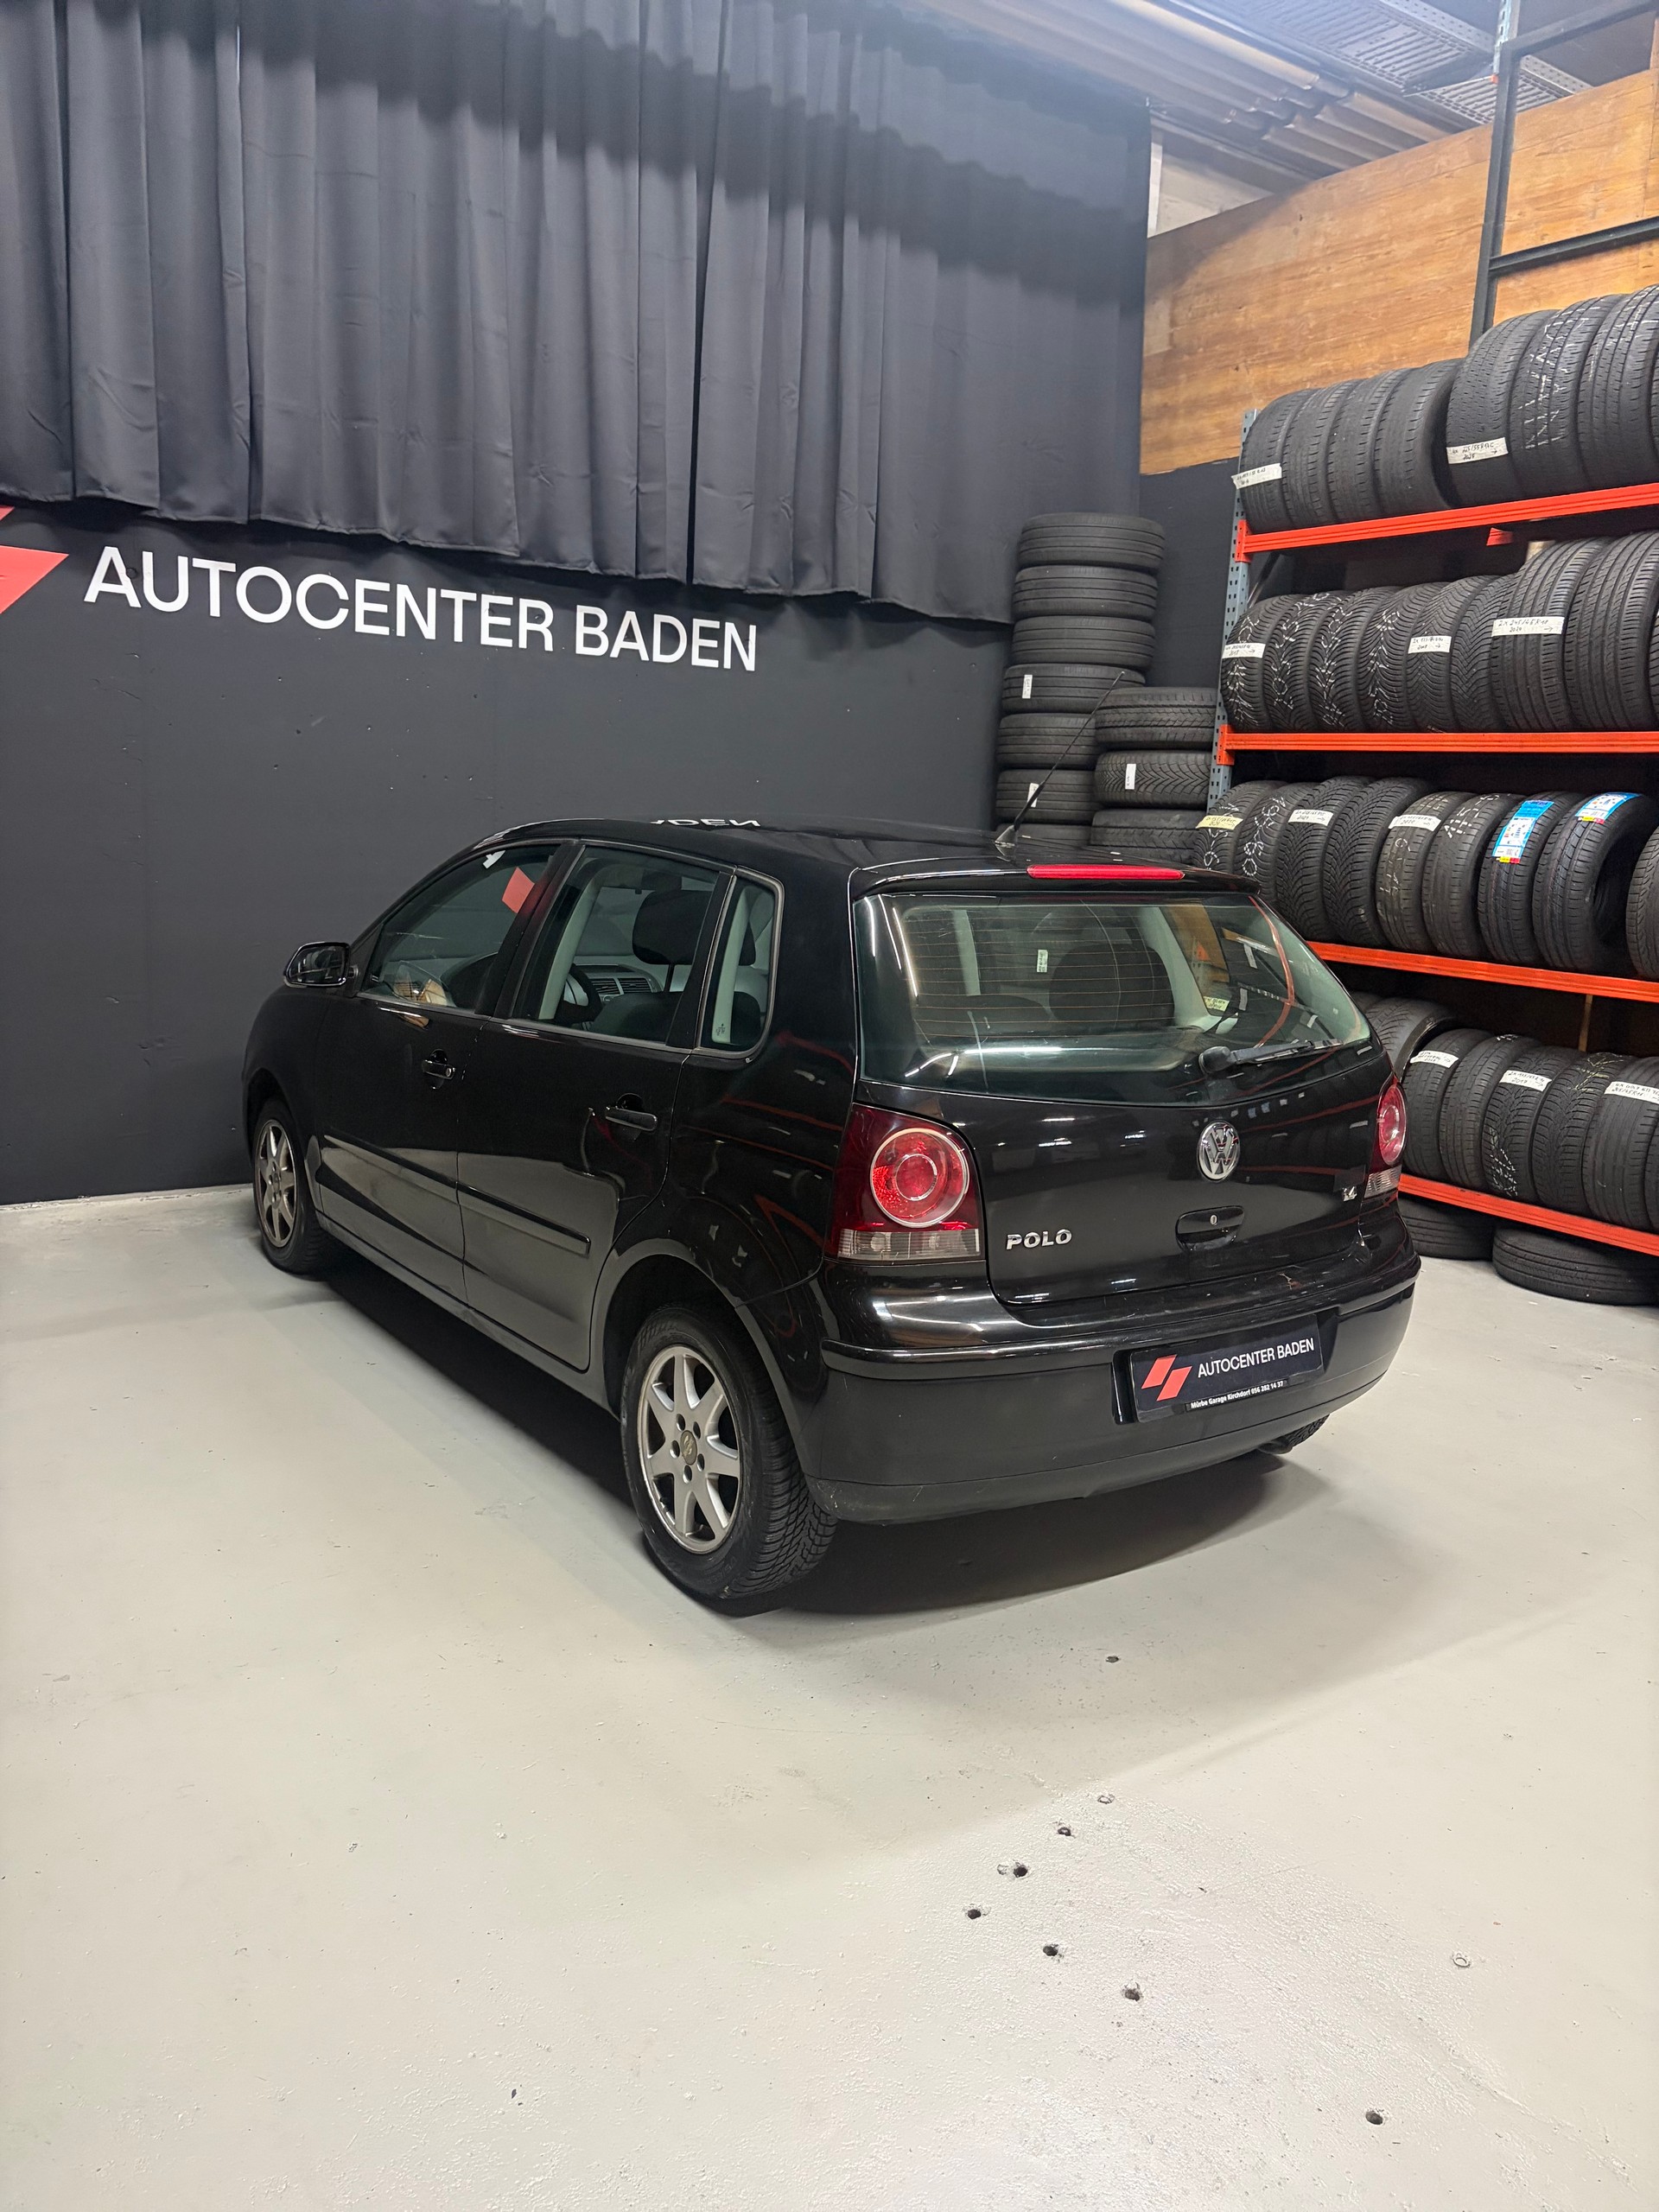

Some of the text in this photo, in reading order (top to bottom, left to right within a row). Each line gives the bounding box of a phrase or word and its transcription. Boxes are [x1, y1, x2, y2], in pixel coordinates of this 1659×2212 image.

[84, 545, 757, 671] AUTOCENTER BADEN
[1006, 1229, 1072, 1250] POLO
[1198, 1337, 1314, 1378] AUTOCENTER BADEN
[1208, 1395, 1227, 1403] Garage
[1227, 1389, 1251, 1400] Kirchdorf
